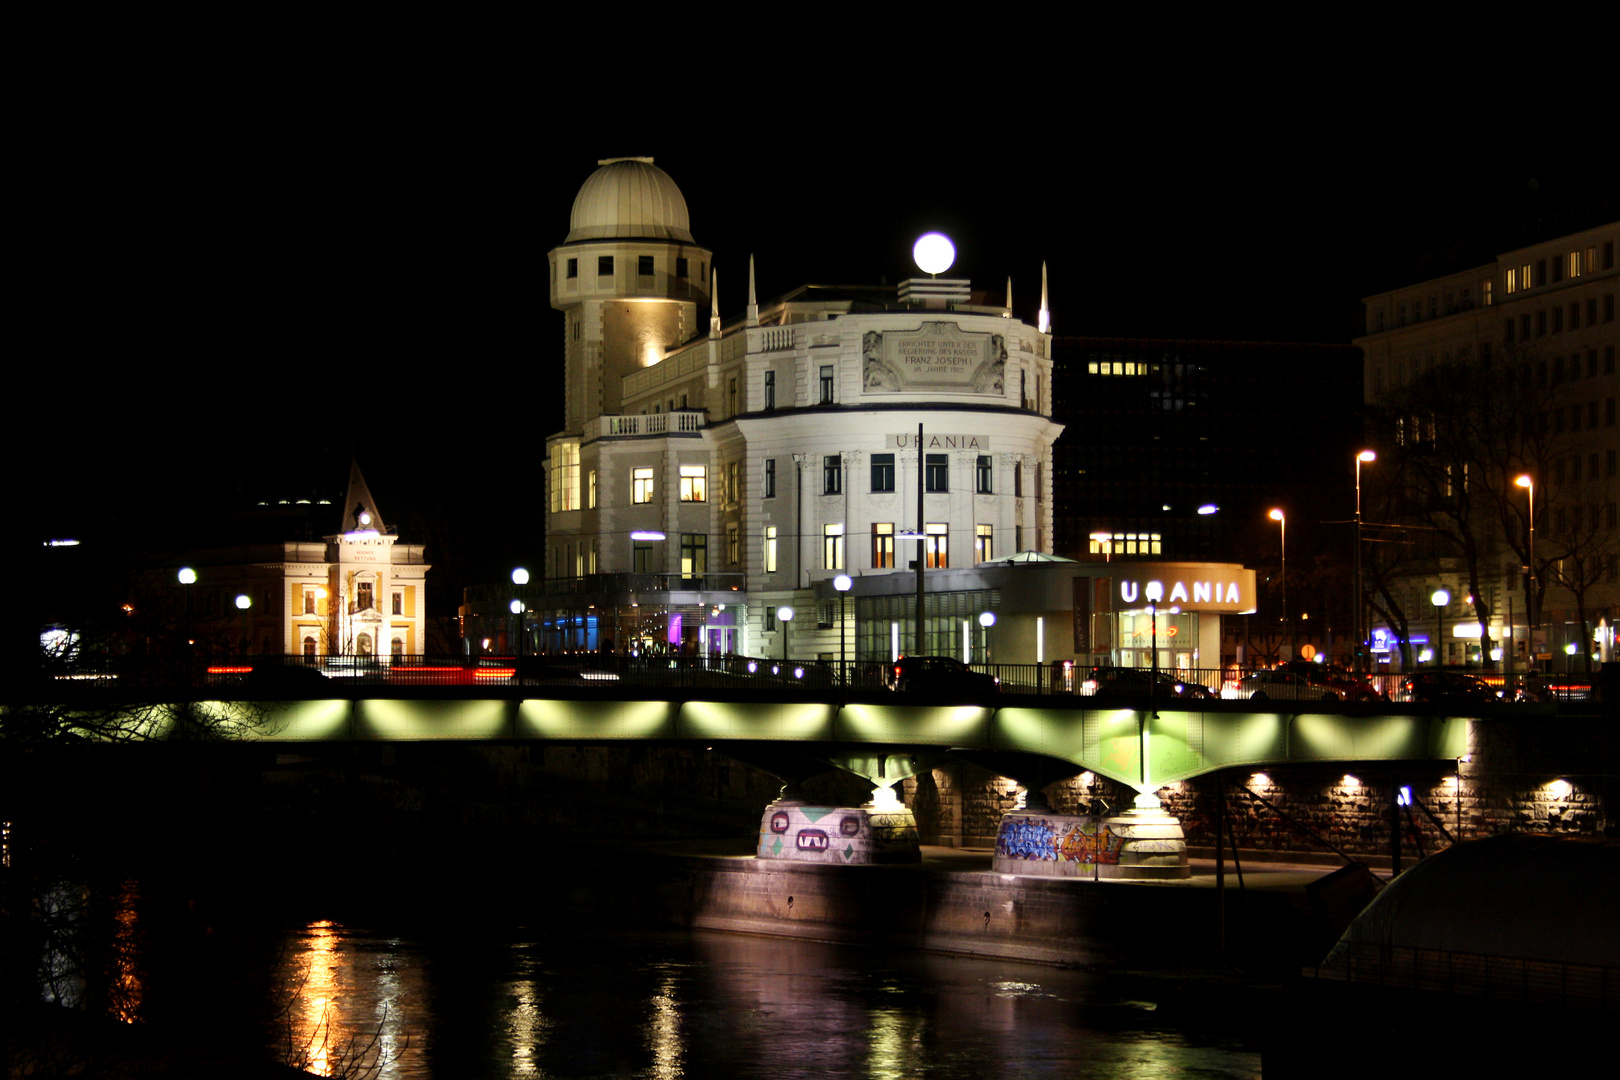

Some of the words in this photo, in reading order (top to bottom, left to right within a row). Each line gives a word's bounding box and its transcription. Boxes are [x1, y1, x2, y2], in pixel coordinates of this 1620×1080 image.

[905, 357, 931, 365] FRANZ
[934, 357, 968, 365] JOSEPH
[896, 435, 980, 449] URANIA
